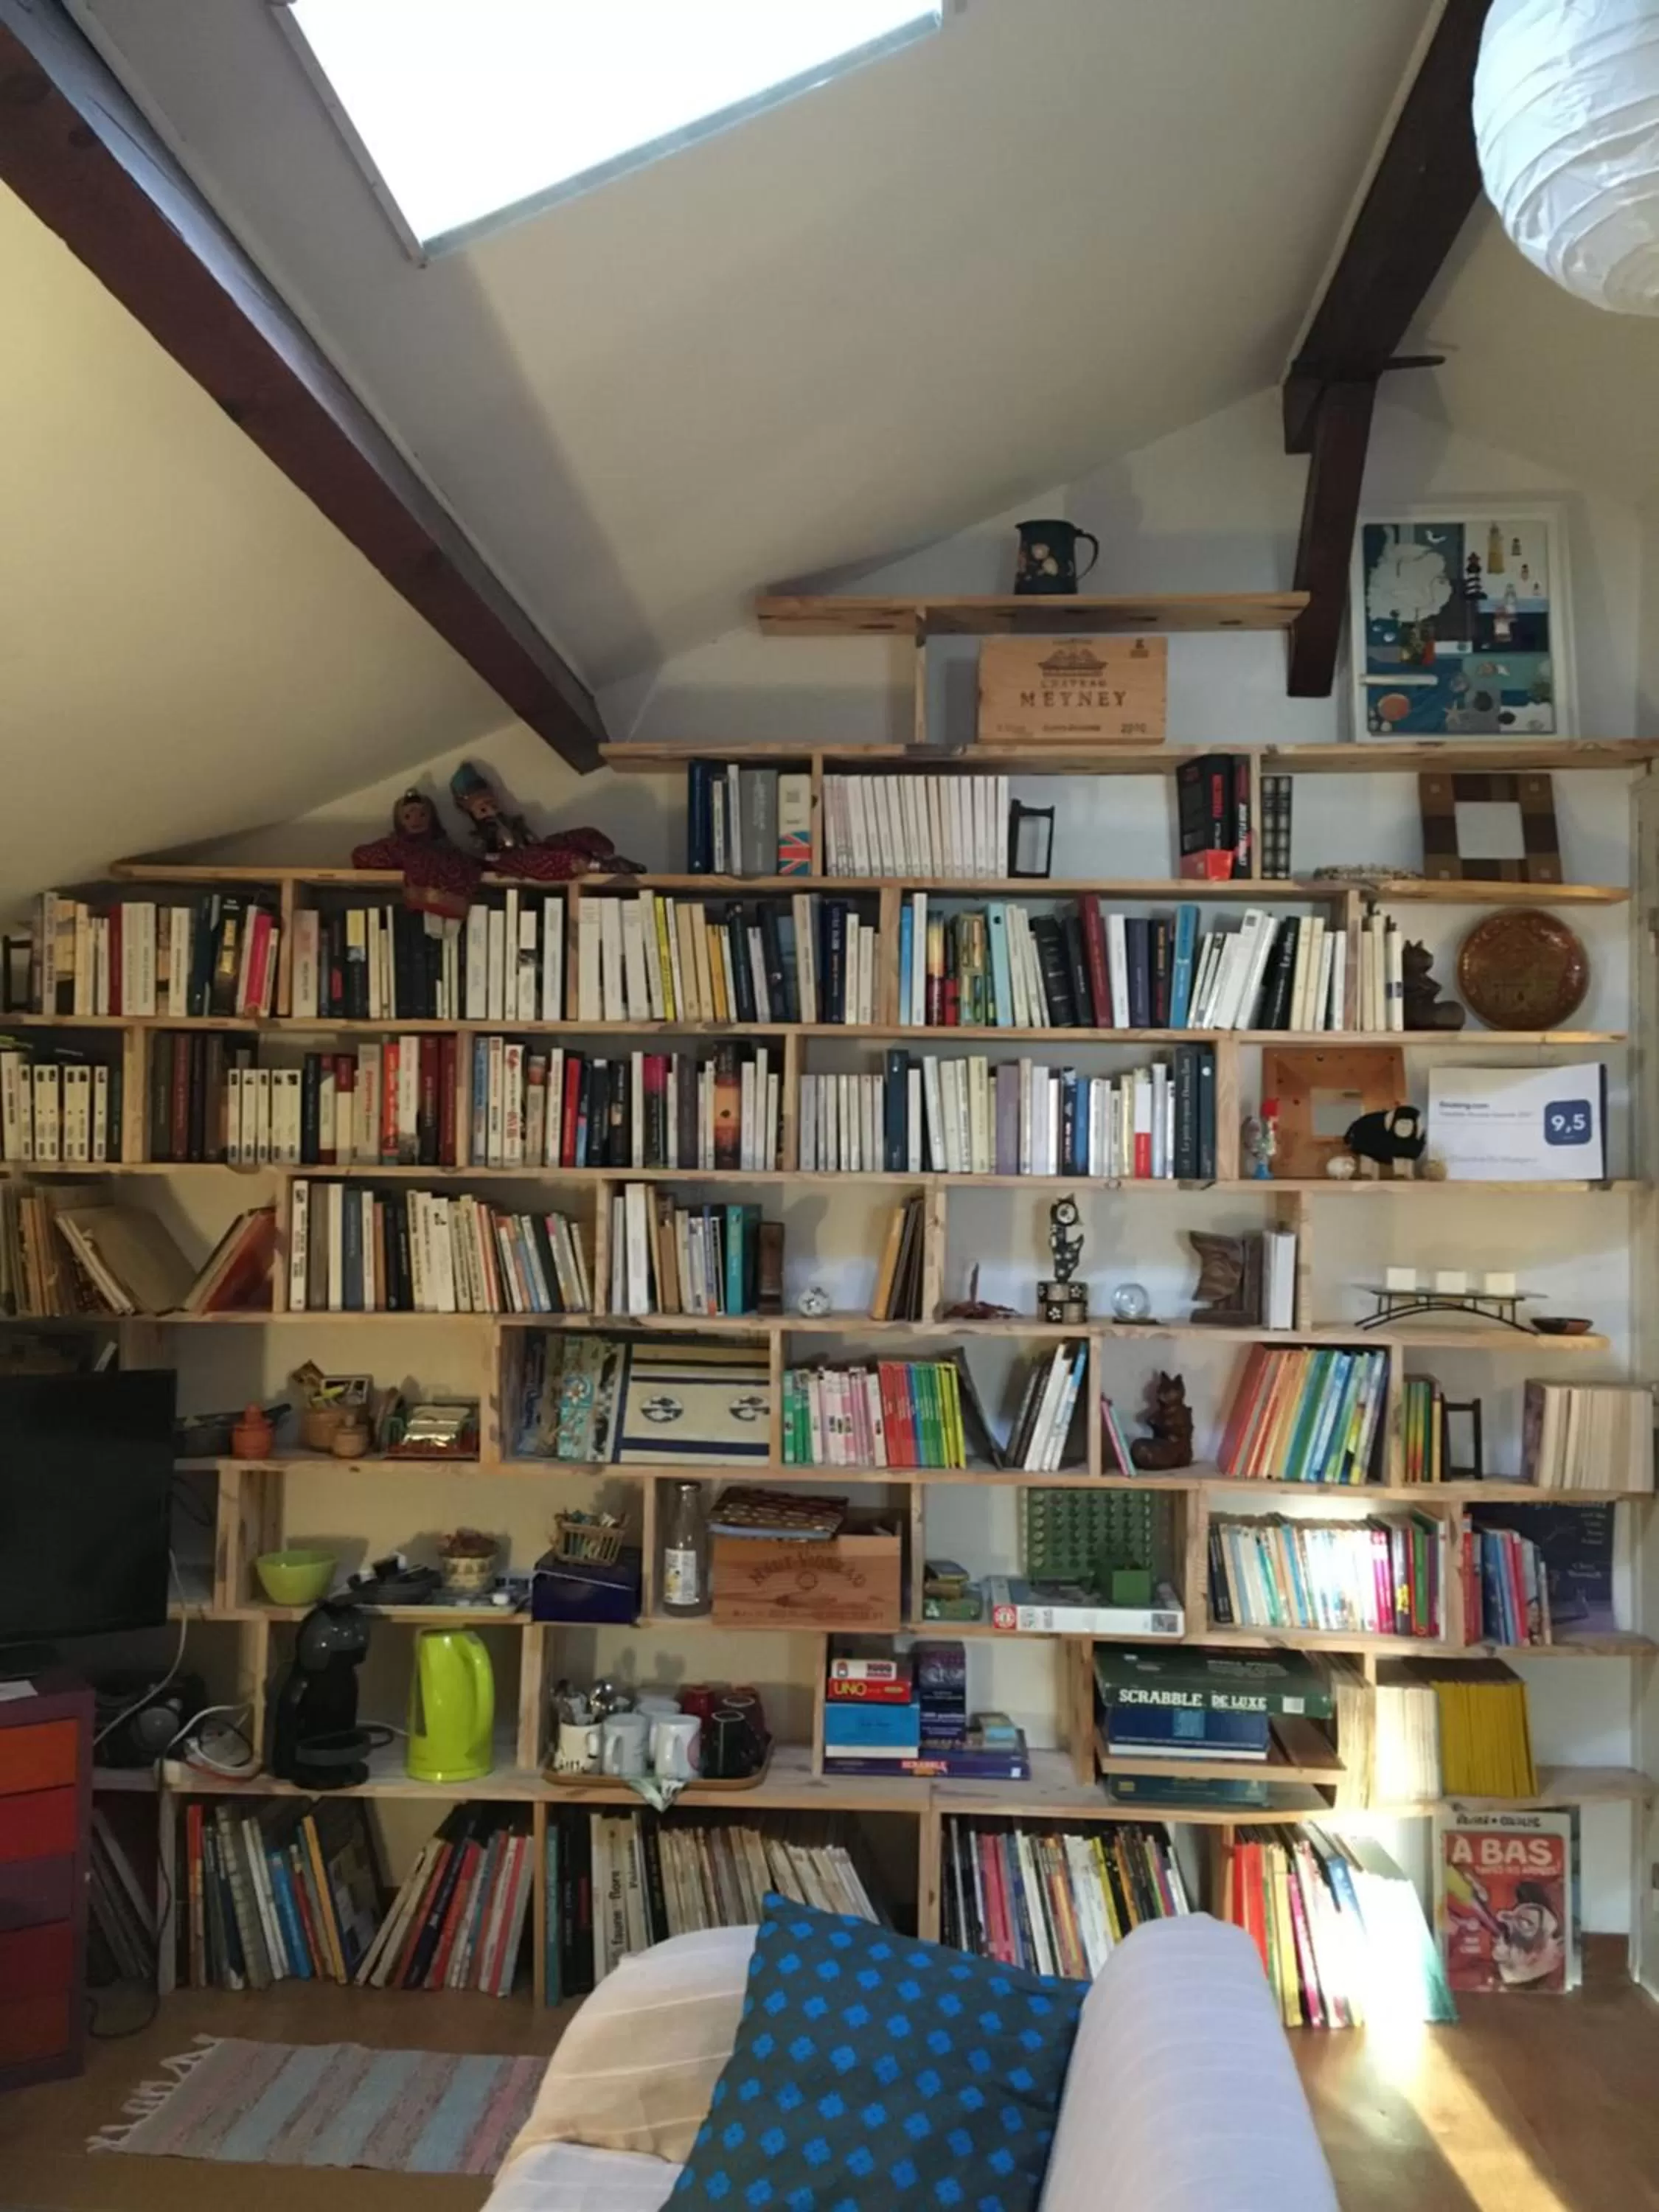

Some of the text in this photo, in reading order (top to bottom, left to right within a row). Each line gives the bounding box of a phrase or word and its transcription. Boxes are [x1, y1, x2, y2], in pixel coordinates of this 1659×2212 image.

[1020, 690, 1127, 708] MEYNEY
[1551, 1113, 1586, 1133] 9,5
[834, 1680, 868, 1697] UNO
[1118, 1688, 1204, 1708] SCRABBLE
[1480, 1837, 1554, 1866] BAS
